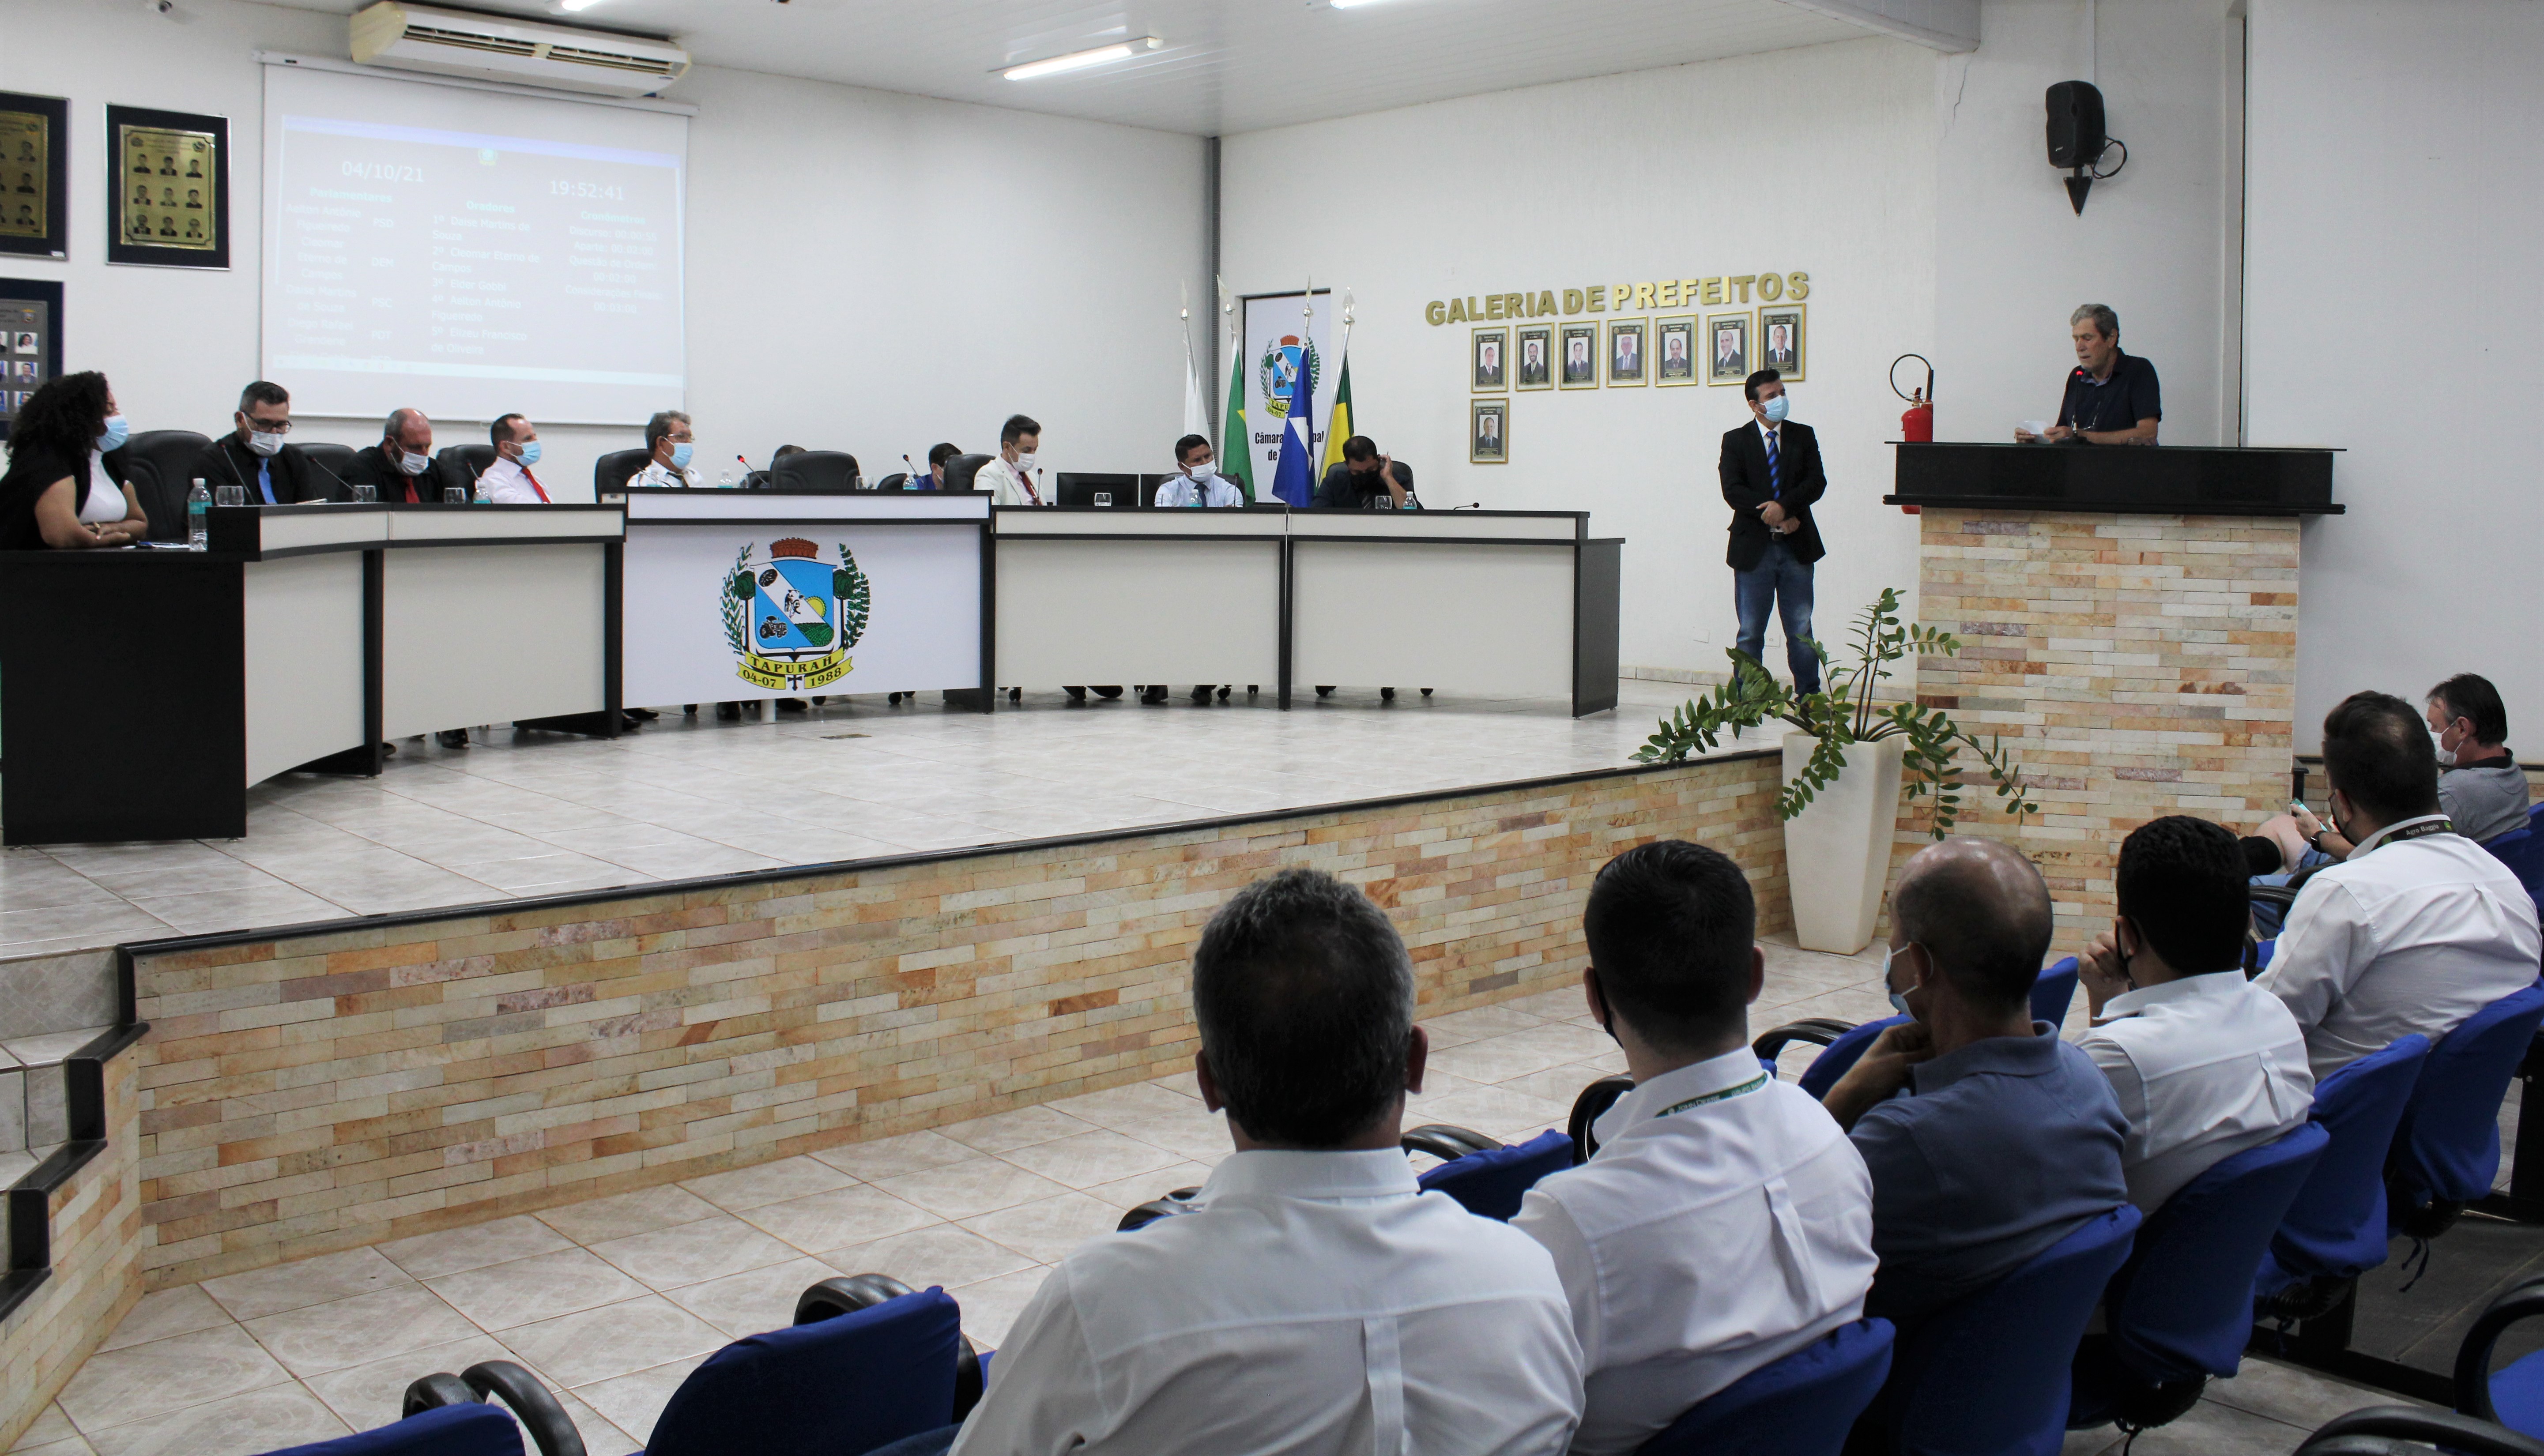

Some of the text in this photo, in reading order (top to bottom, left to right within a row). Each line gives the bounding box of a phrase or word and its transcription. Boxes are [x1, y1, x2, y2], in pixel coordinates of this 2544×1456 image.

[342, 161, 424, 183] 04/10/21
[310, 187, 392, 203] Parlamentares
[550, 180, 625, 201] 19:52:41
[466, 200, 516, 213] Oradores
[373, 218, 394, 228] PSD
[451, 216, 478, 227] Daise
[481, 219, 516, 230] Martins
[518, 222, 530, 231] de
[581, 210, 646, 225] Cronômetros
[297, 220, 350, 233] Figueiredo
[569, 226, 611, 238] Discurso:
[433, 230, 463, 241] Souza
[302, 237, 344, 248] Cleomar
[574, 241, 653, 256] Aparte: 00:02:00
[298, 252, 347, 264] Eterno de
[451, 248, 491, 259] Cleomar
[494, 251, 525, 262] Eterno
[528, 253, 540, 263] de
[372, 257, 394, 267] DEM
[432, 262, 471, 273] Campos
[569, 256, 607, 267] Questão
[610, 259, 622, 268] de
[302, 268, 343, 280] Campos
[594, 272, 636, 284] 00:02:00
[451, 279, 475, 290] Elder
[478, 281, 506, 291] Gobbi
[565, 285, 631, 299] Considerações
[372, 297, 393, 308] PSC
[484, 297, 522, 309] Antônio
[1425, 271, 1809, 326] GALERIA DE PREFEITOS
[314, 301, 346, 312] Souza
[594, 301, 637, 314] 00:03:00
[432, 310, 483, 322] Figueiredo
[372, 331, 392, 340] PDT
[450, 327, 479, 338] Elizeu
[482, 330, 528, 341] Francisco
[431, 343, 484, 355] de Oliveira
[1271, 400, 1289, 410] TAPU
[1268, 407, 1281, 417] 04-07
[1255, 432, 1284, 444] Câmara
[1268, 449, 1278, 461] de
[751, 656, 833, 673] TAPURAH
[742, 667, 841, 687] 04-07 1988
